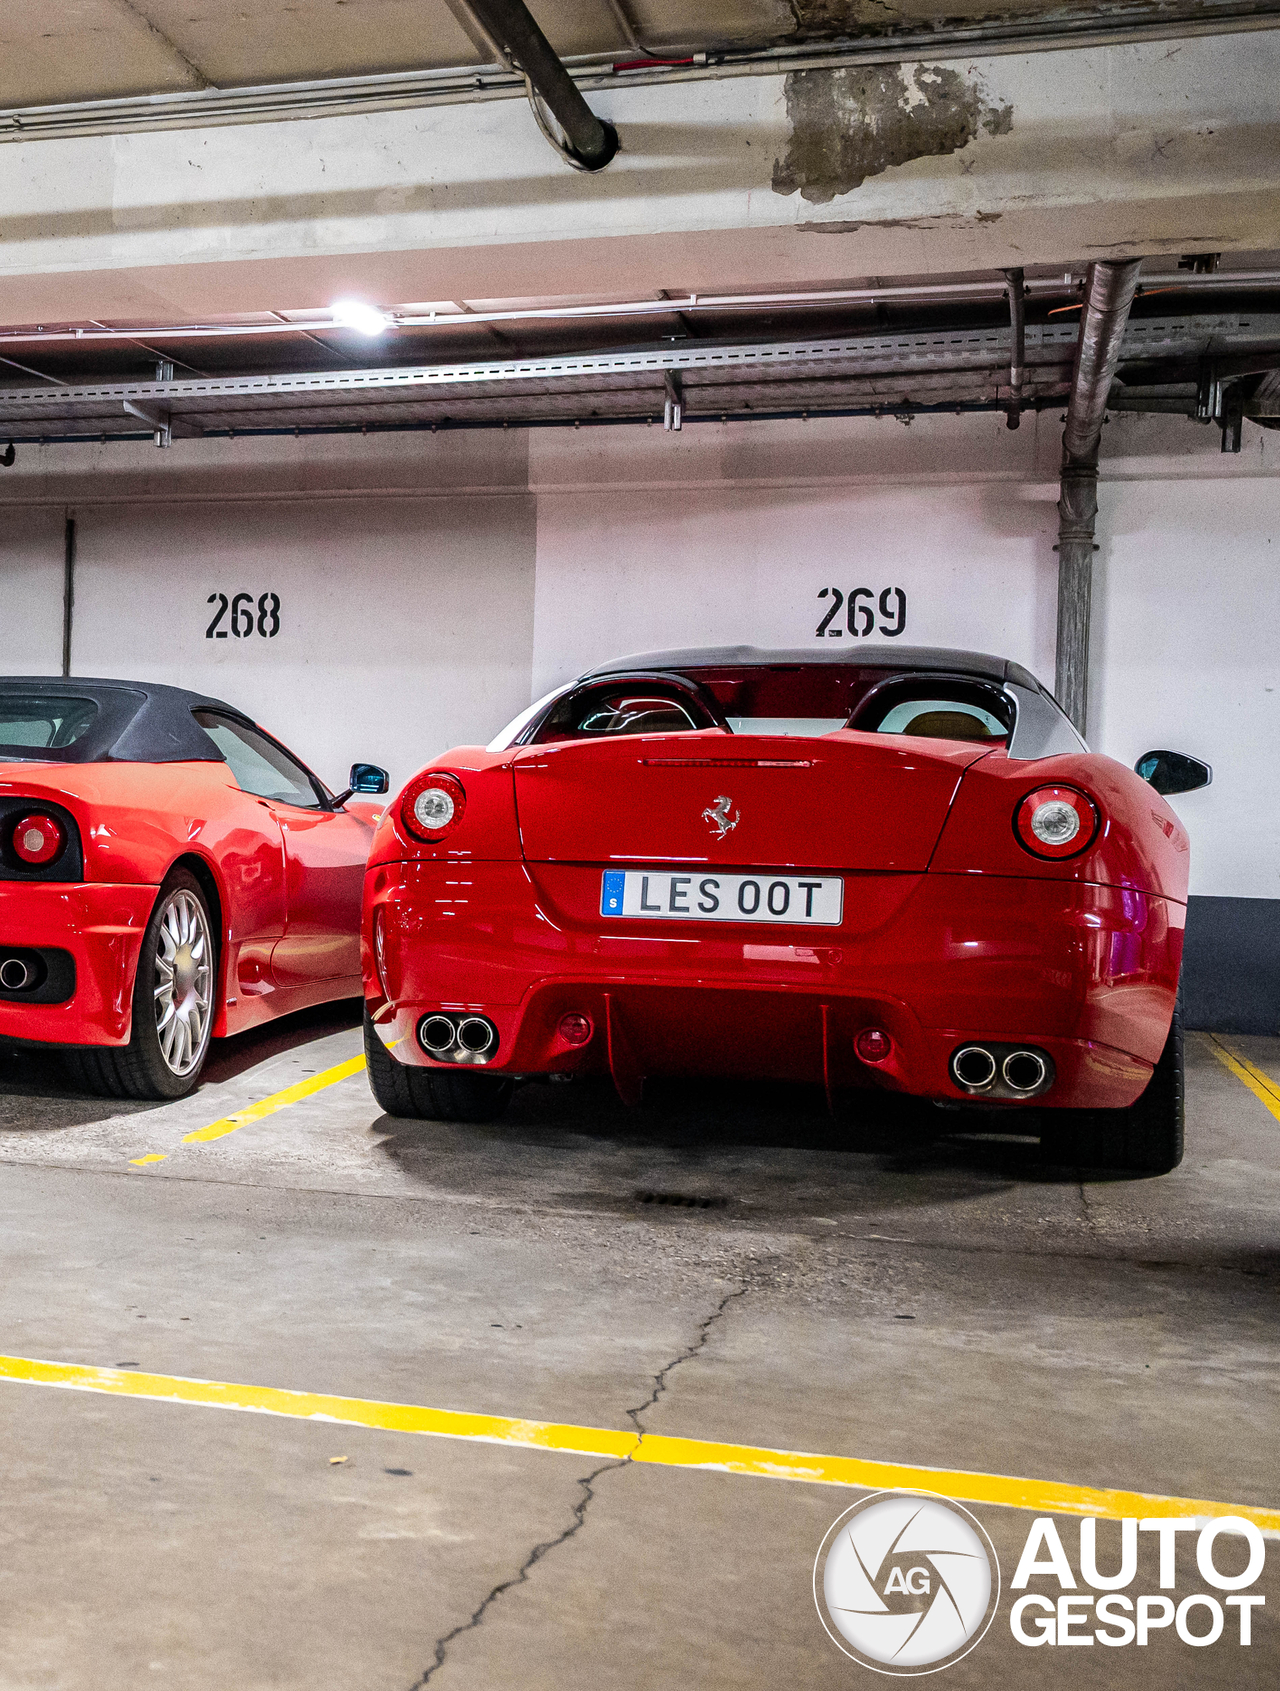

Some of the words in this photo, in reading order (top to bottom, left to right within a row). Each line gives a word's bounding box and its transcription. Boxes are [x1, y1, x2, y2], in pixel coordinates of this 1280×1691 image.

[205, 592, 281, 639] 268
[815, 586, 907, 638] 269
[609, 898, 618, 908] S
[639, 876, 720, 914] LES
